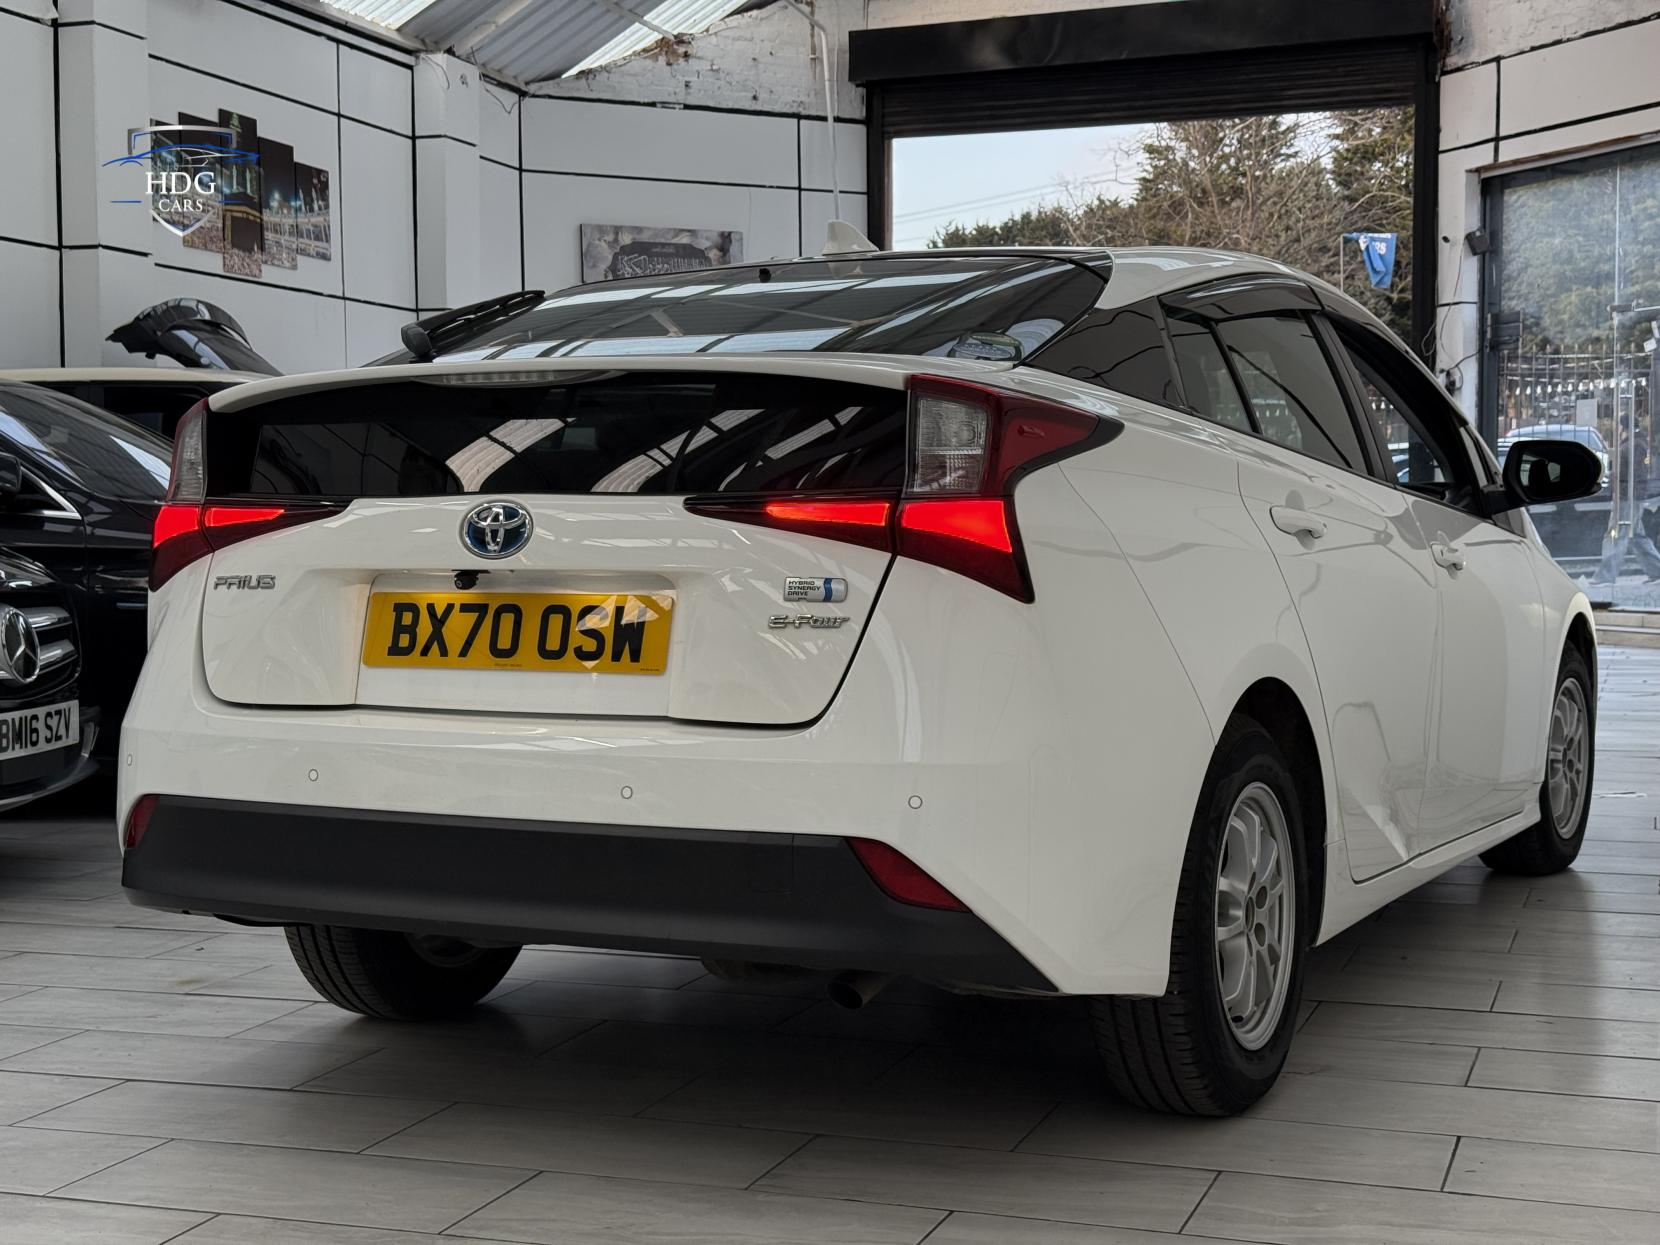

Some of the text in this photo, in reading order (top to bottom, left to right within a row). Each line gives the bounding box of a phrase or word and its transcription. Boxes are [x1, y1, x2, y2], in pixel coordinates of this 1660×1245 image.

[213, 574, 276, 590] PRIUS
[387, 602, 647, 663] BX70 OSW
[0, 706, 72, 754] BM16 SZV
